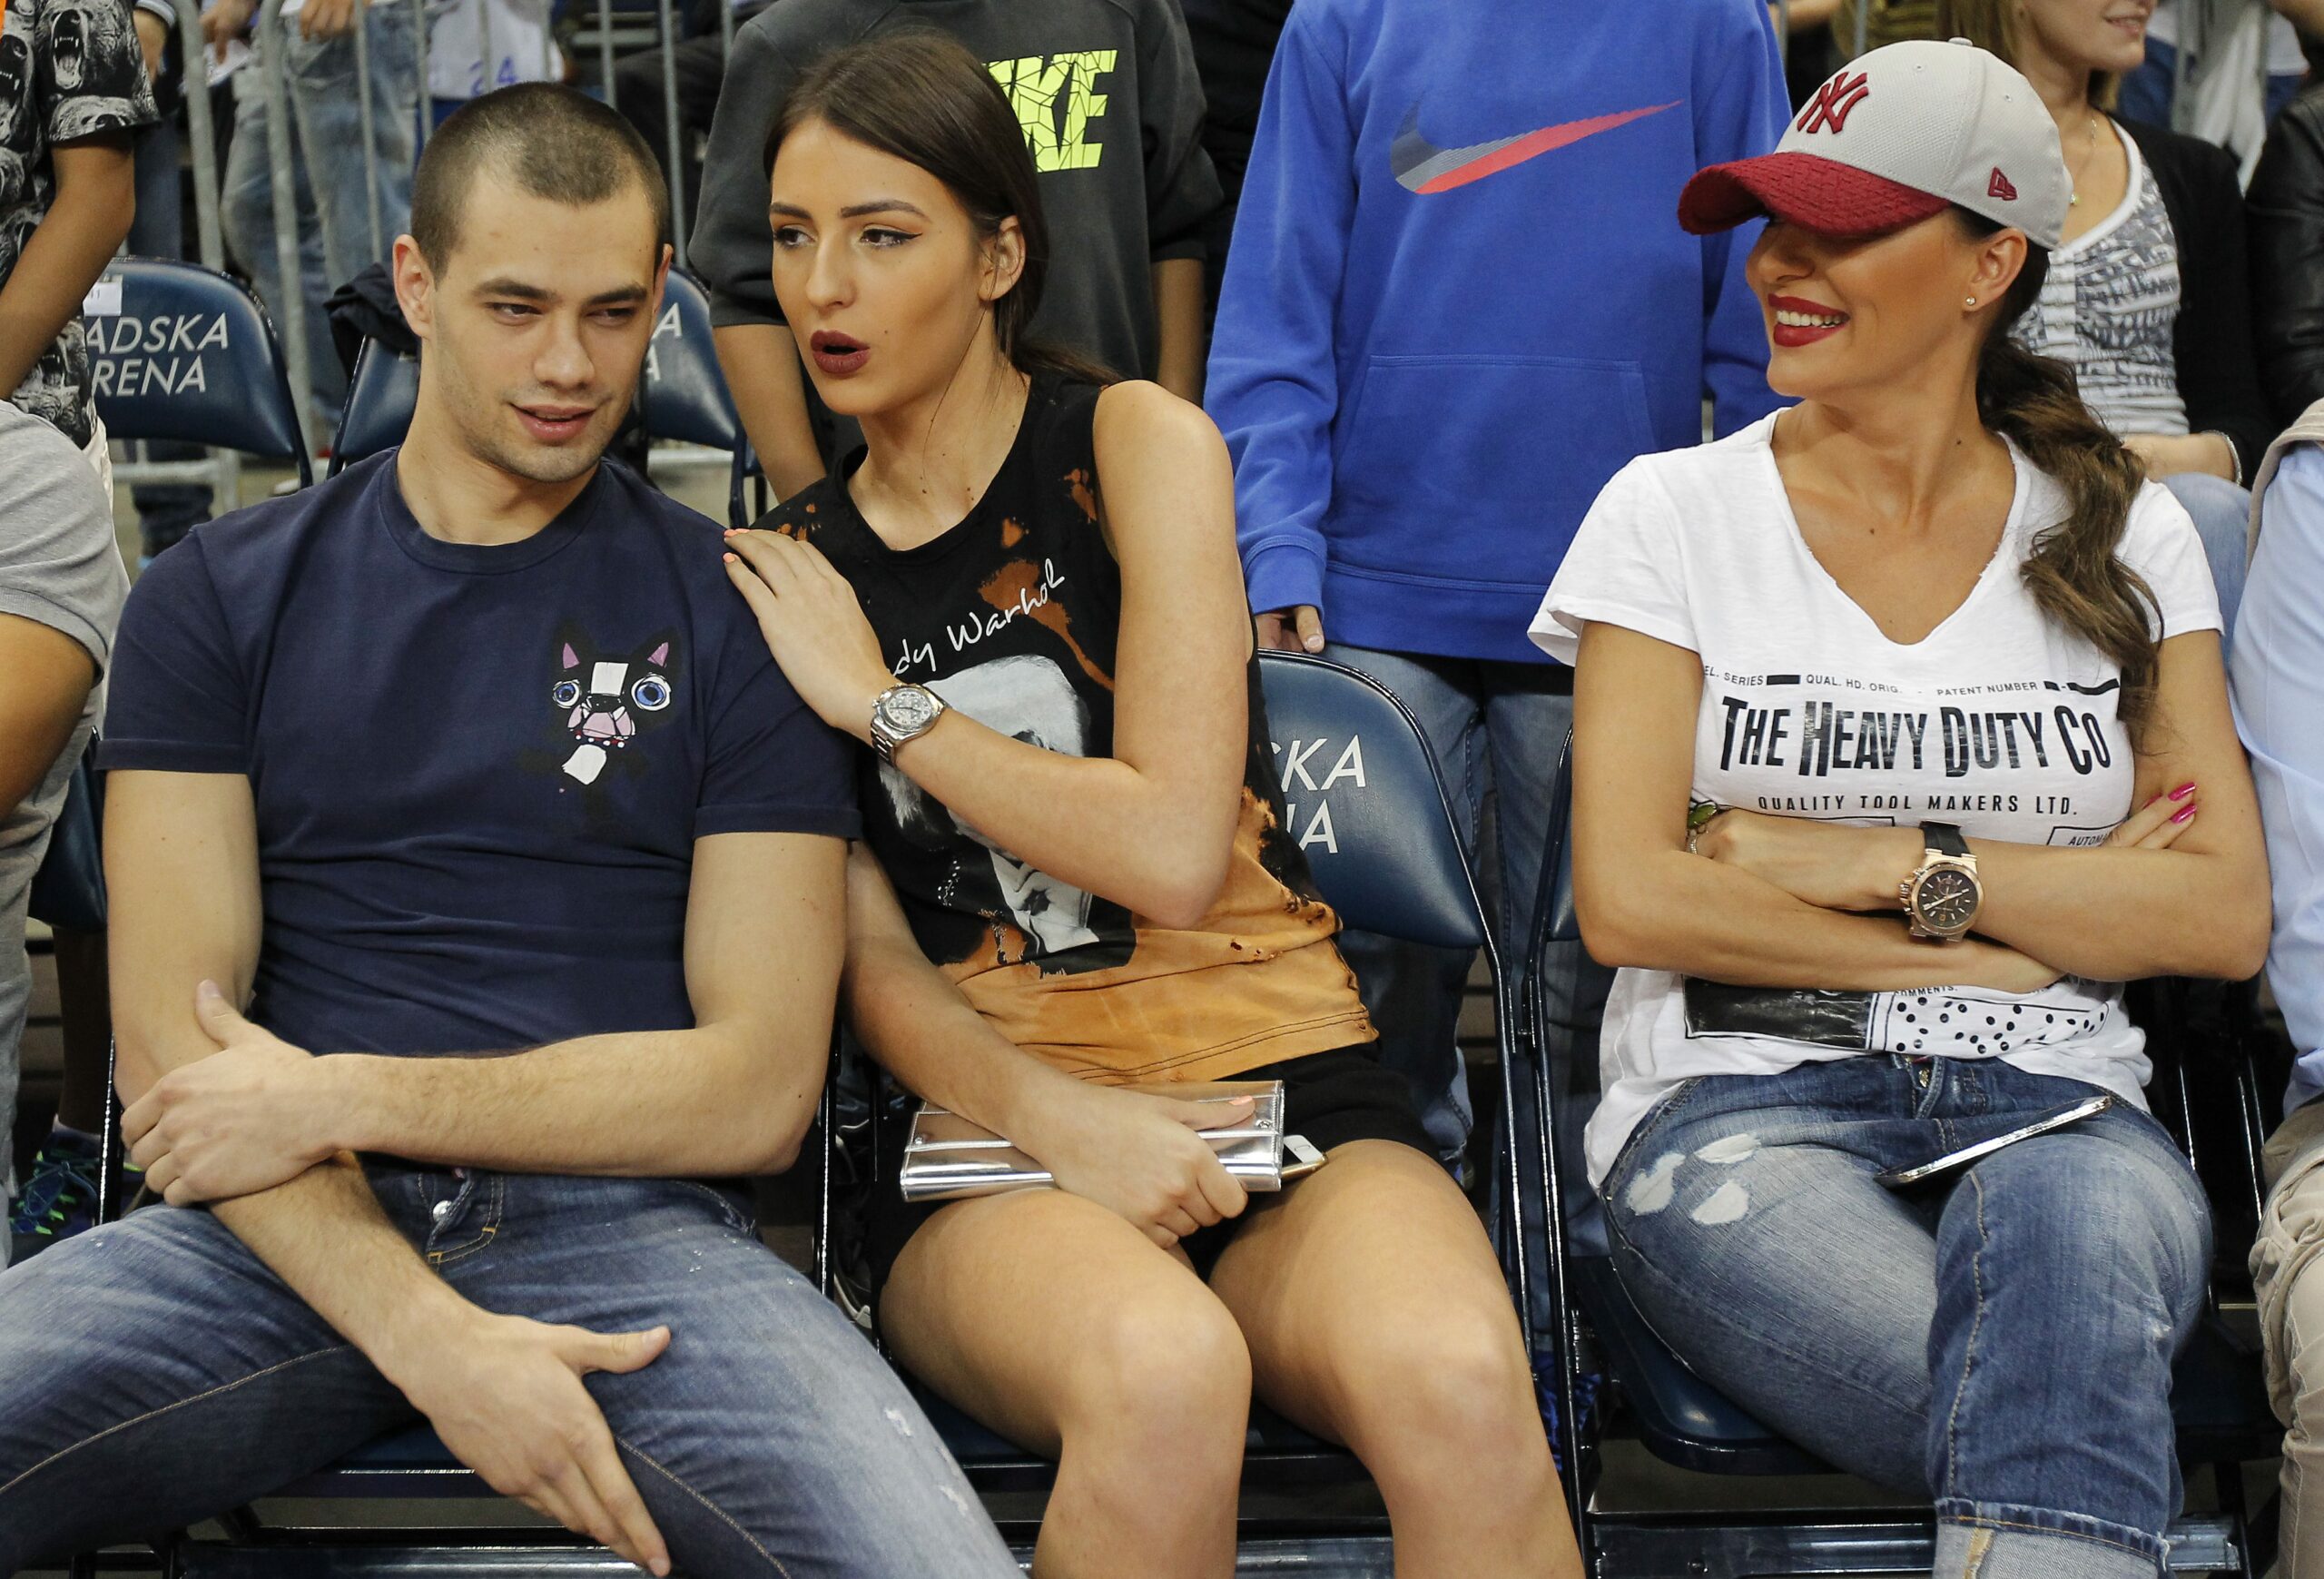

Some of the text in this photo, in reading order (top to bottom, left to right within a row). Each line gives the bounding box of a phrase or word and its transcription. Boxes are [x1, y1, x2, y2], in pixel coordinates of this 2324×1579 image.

[86, 311, 229, 355] ADSKA
[92, 354, 207, 398] RENA
[892, 558, 1066, 676] dy Warhol
[1704, 665, 2039, 696] EL. SERIES QUAL. HD. ORIG. PATENT NUMBER
[1720, 696, 1791, 771] THE
[1798, 700, 1928, 776] HEAVY
[1939, 706, 2050, 778] DUTY
[1758, 795, 2078, 815] QUALITY TOOL MAKERS LTD.
